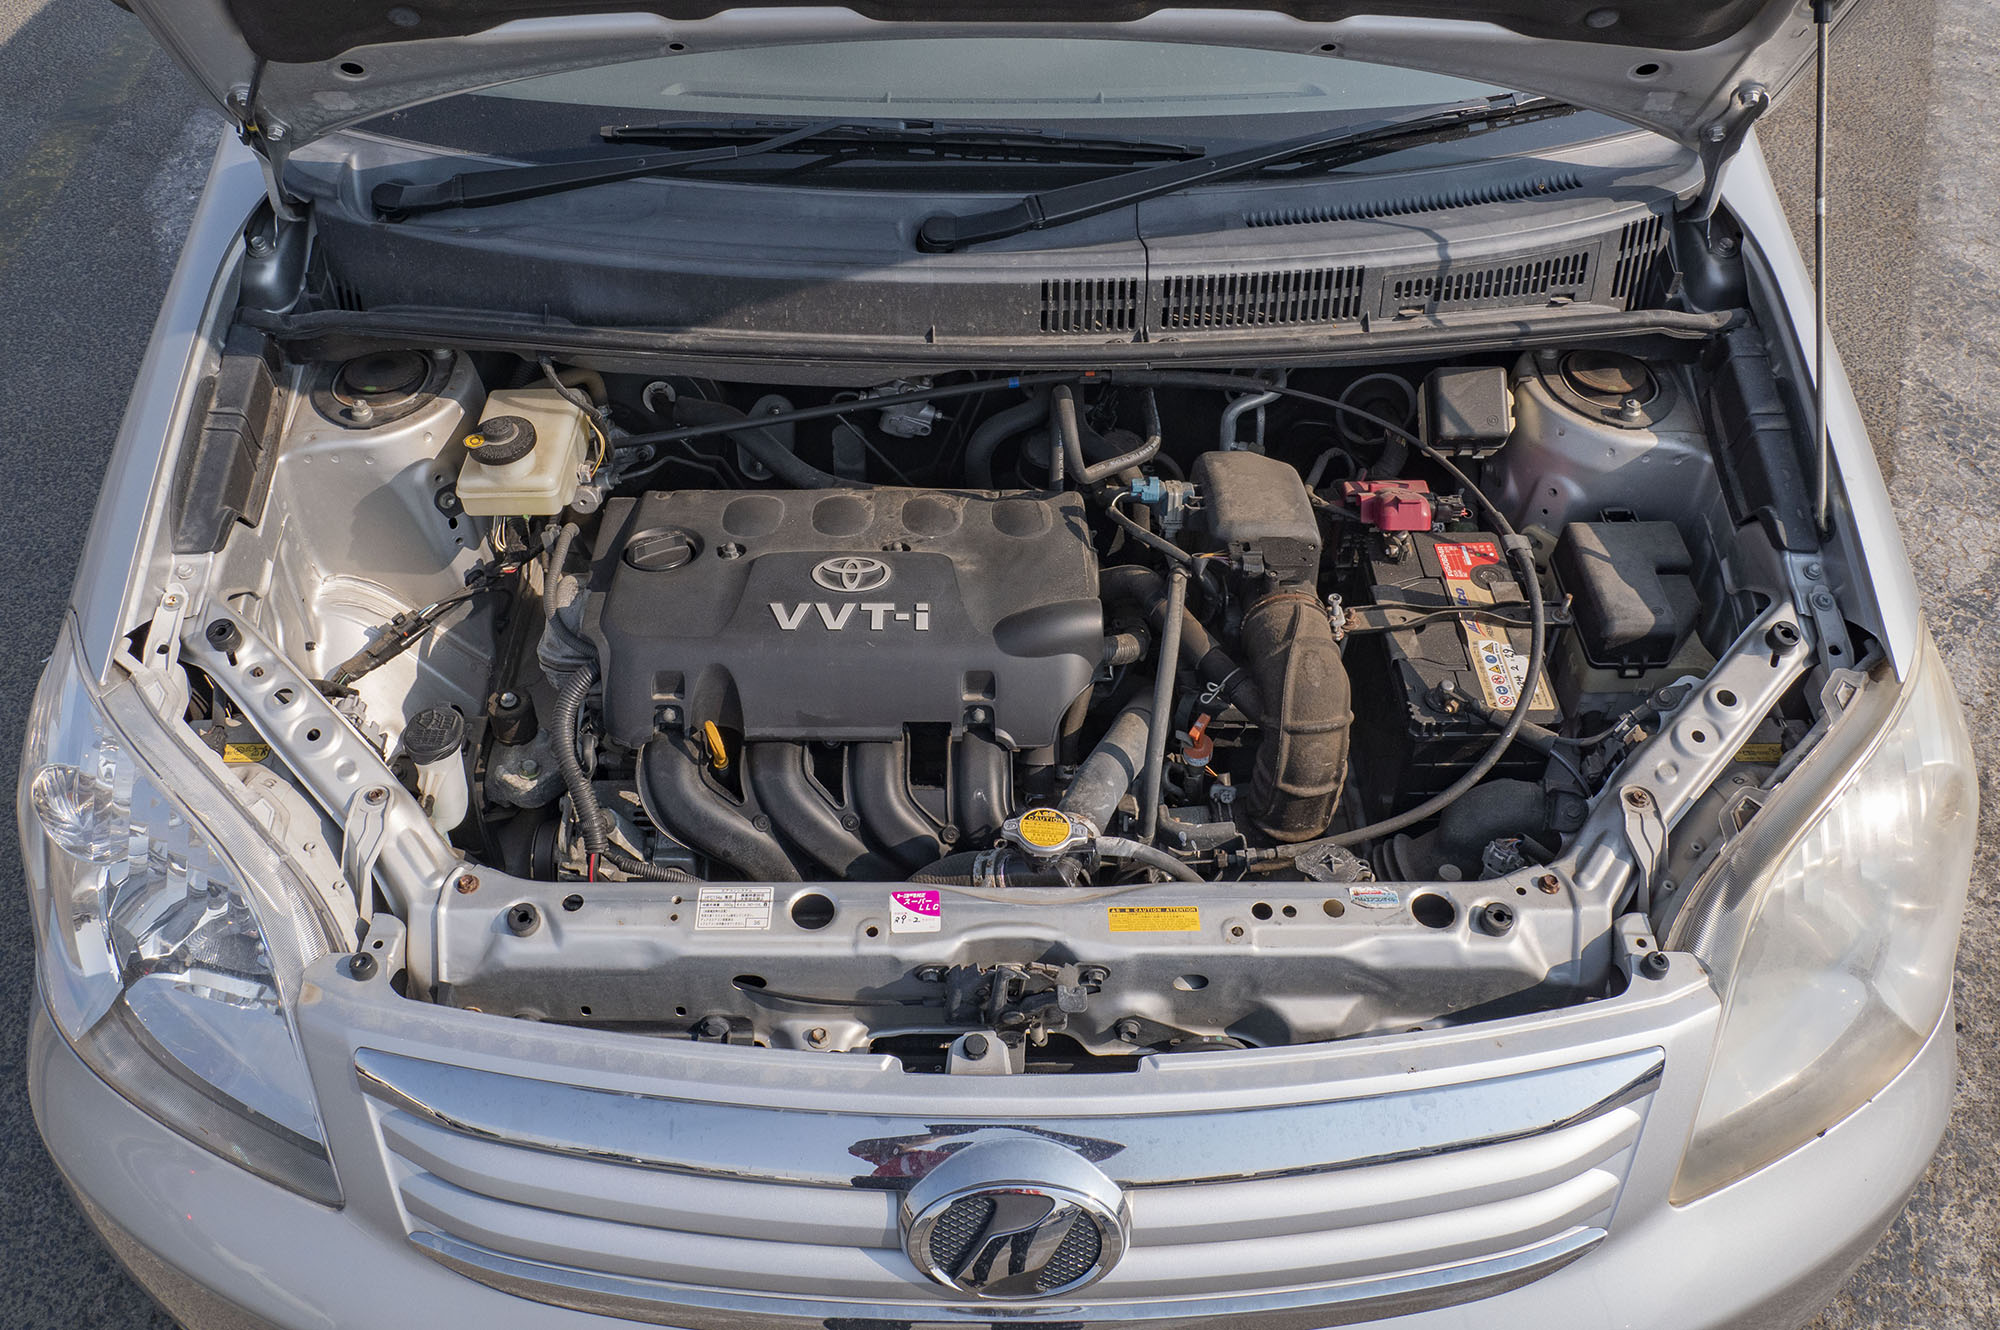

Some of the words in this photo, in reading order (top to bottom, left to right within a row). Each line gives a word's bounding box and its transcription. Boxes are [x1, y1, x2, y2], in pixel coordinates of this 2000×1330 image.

[769, 602, 929, 631] VVT-i
[1028, 815, 1065, 823] CAUTION
[918, 903, 940, 911] LLC
